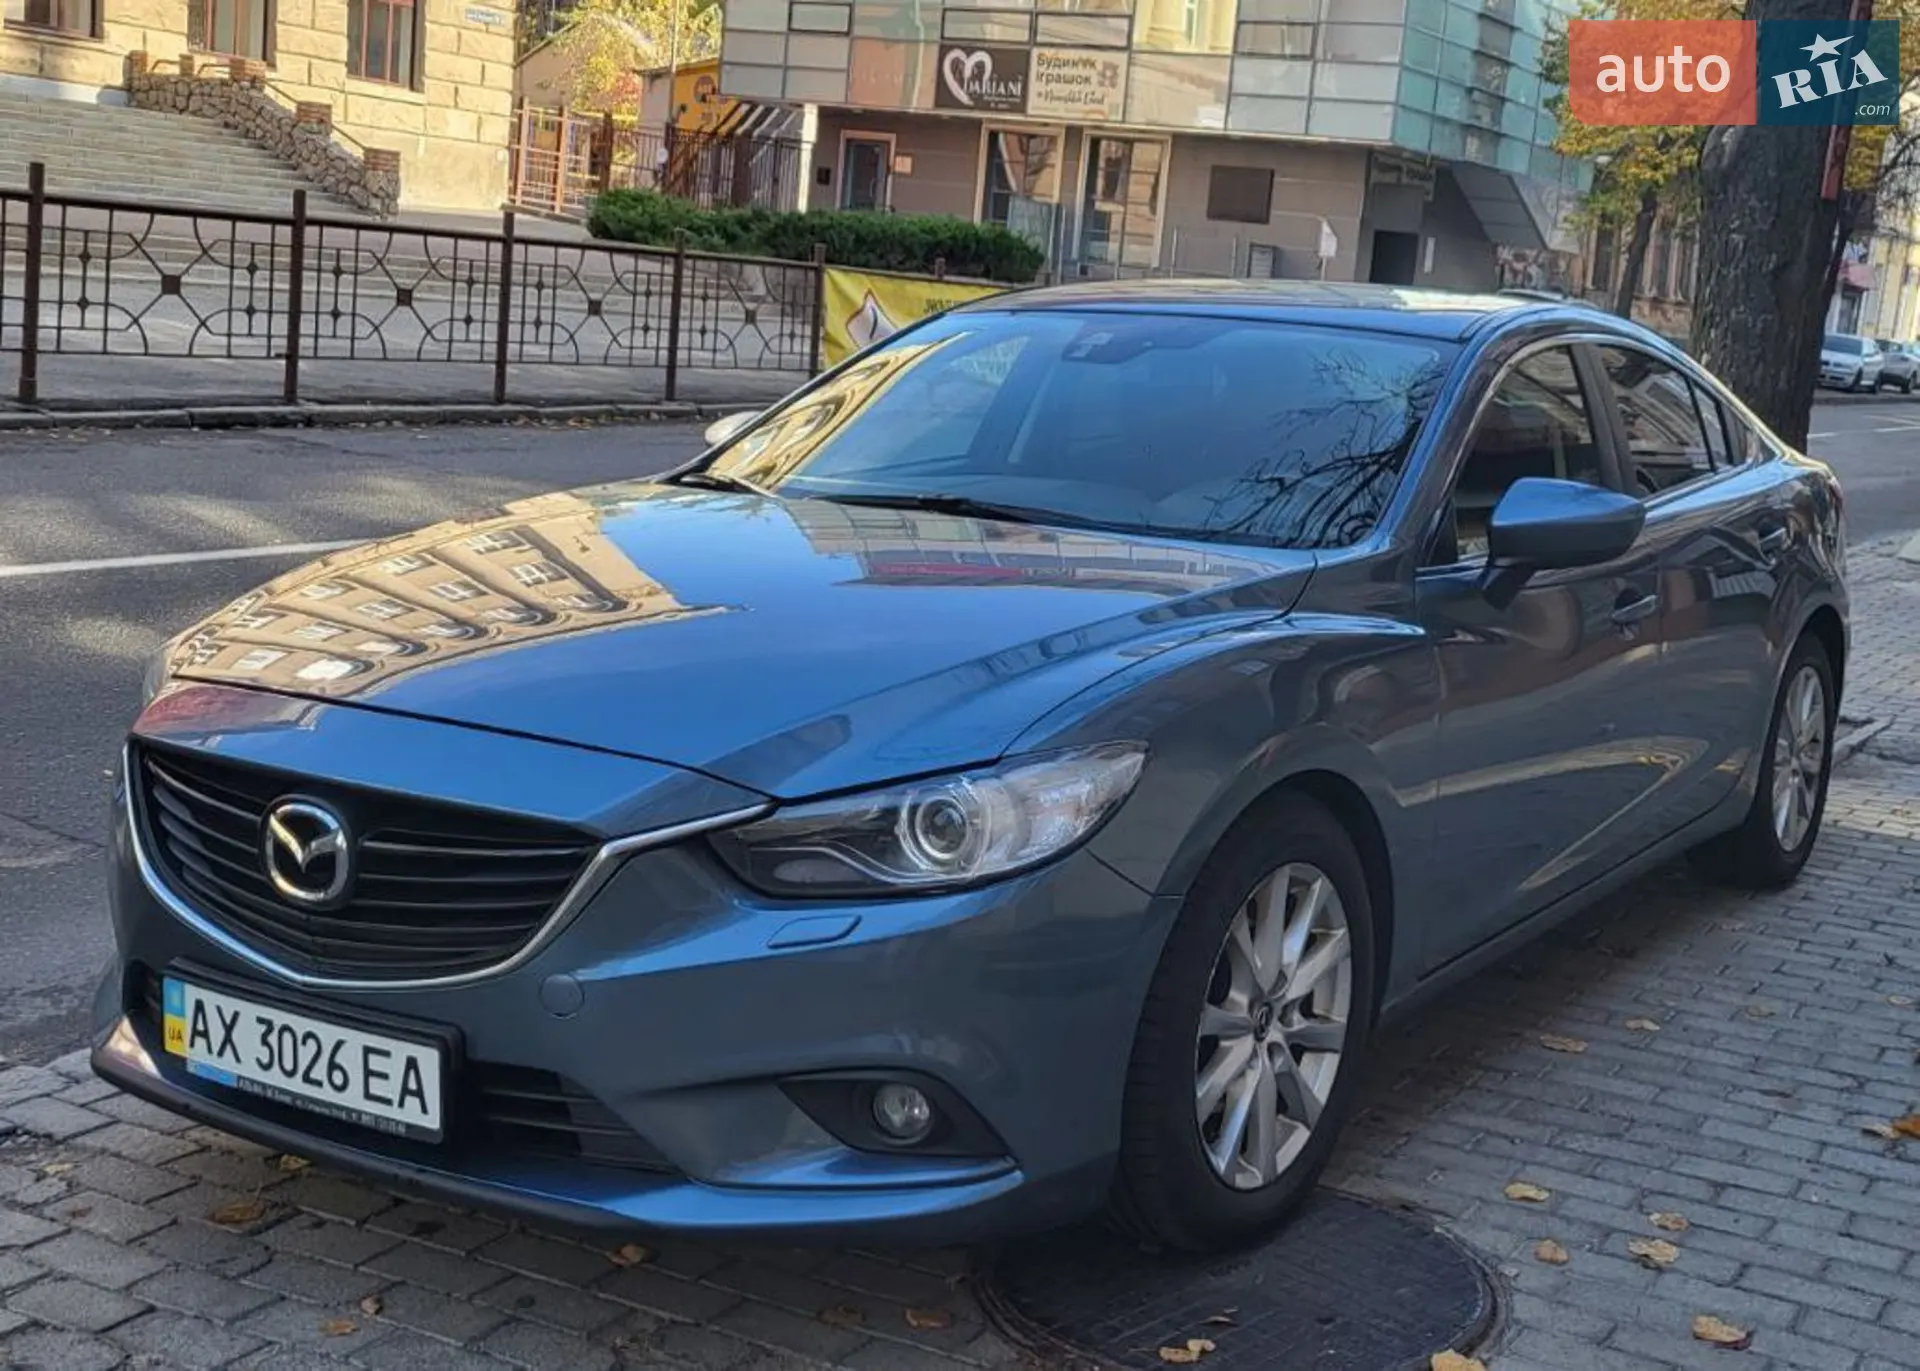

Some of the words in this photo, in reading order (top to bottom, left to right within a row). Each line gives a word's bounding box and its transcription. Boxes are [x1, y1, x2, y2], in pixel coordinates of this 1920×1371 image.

[168, 1026, 183, 1043] UA
[189, 998, 242, 1064] AX
[255, 1016, 350, 1093] 3026
[362, 1045, 429, 1116] EA
